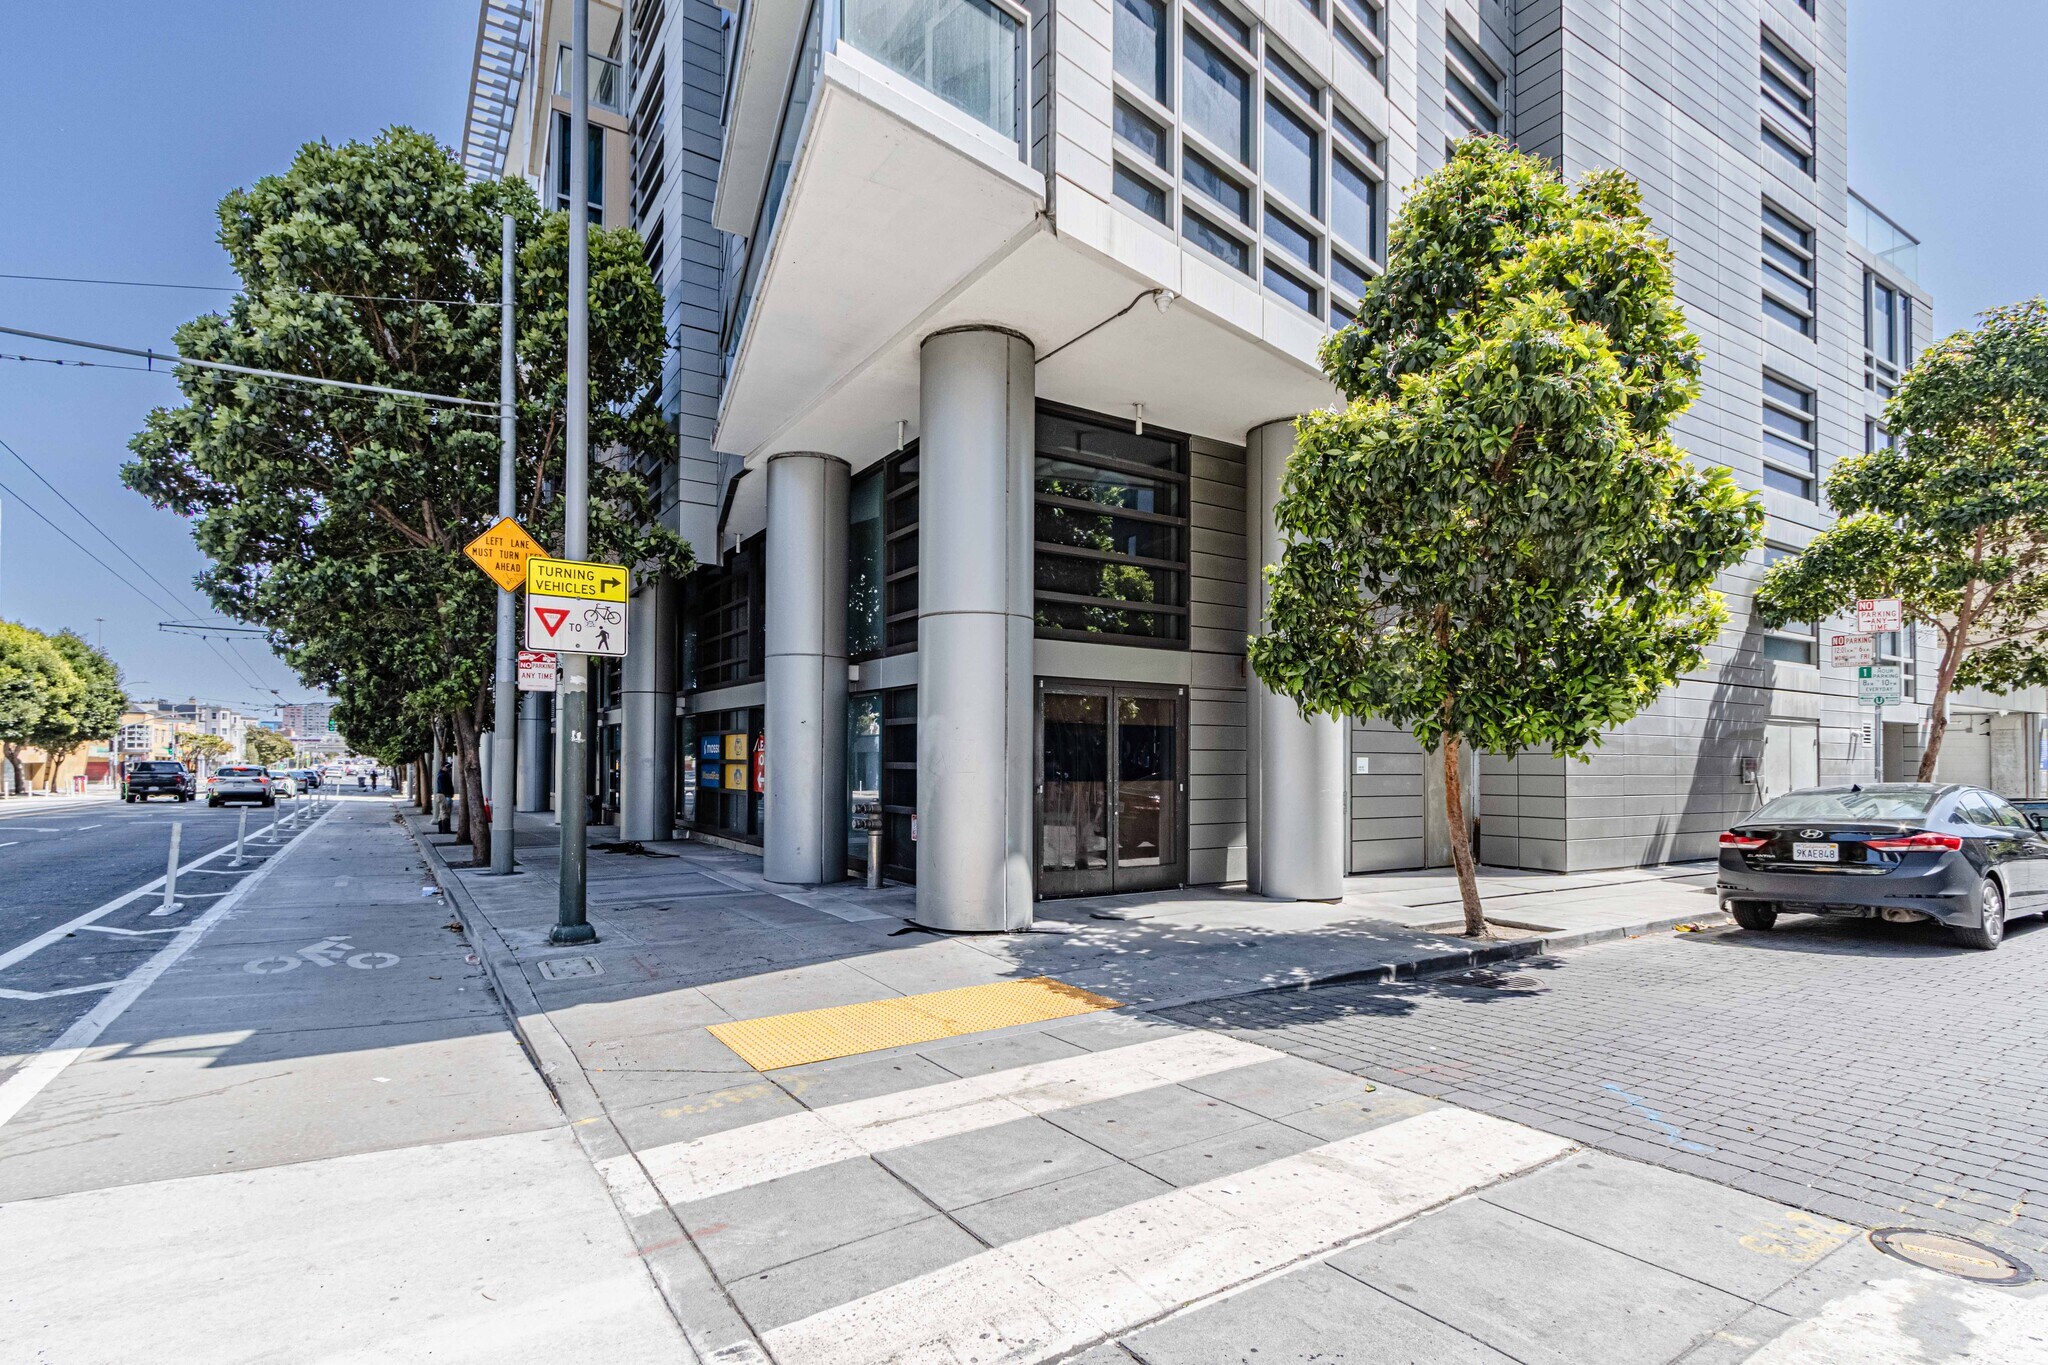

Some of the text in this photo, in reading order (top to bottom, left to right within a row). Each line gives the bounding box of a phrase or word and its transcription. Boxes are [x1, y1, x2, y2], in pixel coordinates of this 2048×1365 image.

[486, 536, 529, 549] LEFT LANE
[472, 548, 492, 557] MUST
[500, 550, 519, 559] TURN
[495, 562, 520, 572] AHEAD
[538, 566, 594, 580] TURNING
[536, 580, 596, 595] VEHICLES
[1860, 602, 1872, 610] NO
[569, 623, 582, 632] TO
[1833, 637, 1843, 645] NO
[1796, 850, 1835, 858] 9KAE848
